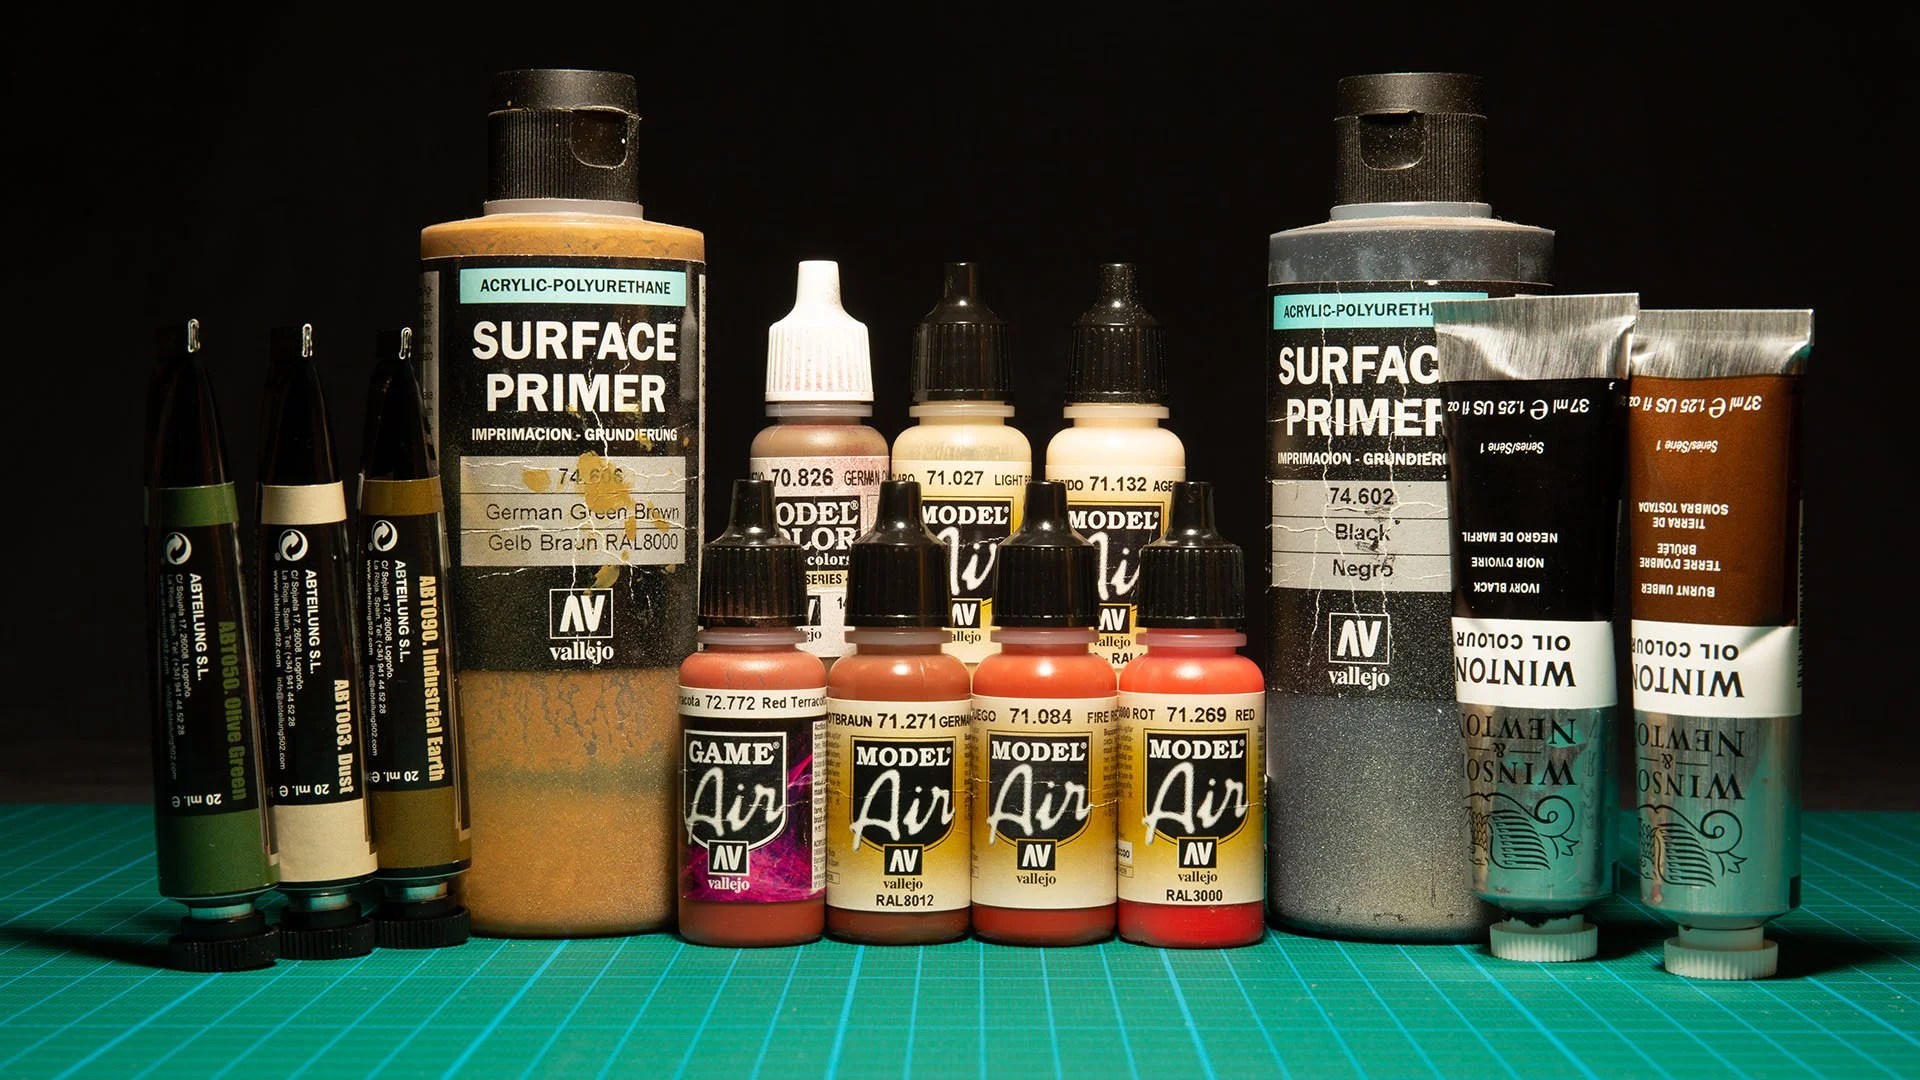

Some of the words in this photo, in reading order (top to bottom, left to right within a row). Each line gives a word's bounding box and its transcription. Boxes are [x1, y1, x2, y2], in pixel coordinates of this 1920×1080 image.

[480, 278, 671, 295] ACRYLIC-POLYURETHANE
[1284, 303, 1432, 318] ACRYLIC-POLYURETH
[472, 320, 677, 362] SURFACE
[1278, 345, 1439, 385] SURFAC
[486, 373, 666, 413] PRIMER
[1447, 401, 1459, 412] oz
[1474, 400, 1494, 416] US
[1498, 400, 1525, 415] 1.25
[1629, 396, 1640, 408] oz
[1655, 397, 1677, 413] US
[1680, 398, 1705, 413] 1.25
[584, 428, 678, 442] GRUNDIERUNG
[1480, 442, 1485, 454] 1
[1656, 440, 1661, 451] 1
[771, 468, 834, 487] 70.826
[844, 470, 879, 486] GERMAN
[927, 470, 984, 486] 71.027
[994, 475, 1022, 486] LIGHT
[1089, 476, 1147, 492] 71.132
[1153, 481, 1173, 492] AGE
[1330, 487, 1394, 505] 74.602
[486, 503, 562, 521] German
[635, 503, 680, 520] Brown
[775, 500, 858, 526] ODEL
[1639, 502, 1678, 514] TOSTADA
[1681, 503, 1729, 516] SOMBRA
[1652, 517, 1665, 528] DE
[1669, 517, 1705, 530] TIERRA
[1335, 523, 1390, 541] Black
[1462, 531, 1497, 542] MARFIL
[1499, 531, 1514, 543] DE
[1516, 532, 1558, 543] NEGRO
[488, 534, 531, 551] Gelb
[540, 534, 598, 551] Braun
[606, 533, 678, 551] RAL8000
[1333, 559, 1393, 581] Negro
[1471, 556, 1514, 568] D'IVOIRE
[1516, 557, 1545, 568] NOIR
[1639, 557, 1680, 570] D'OMBRE
[1684, 559, 1721, 572] TERRE
[381, 571, 390, 601] Sojuela
[1474, 581, 1507, 593] BLACK
[1509, 582, 1540, 593] IVORY
[1641, 583, 1674, 595] UMBER
[1676, 585, 1715, 598] BURNT
[290, 581, 299, 611] Sojuela
[395, 560, 410, 636] ABTEILUNG
[189, 573, 208, 653] ABTEILUNG
[305, 569, 320, 647] ABTEILUNG
[952, 631, 981, 644] allejo
[1098, 636, 1131, 649] allejo
[1456, 631, 1523, 650] COLOUR
[1532, 635, 1571, 651] OIL
[550, 642, 614, 664] vallejo
[1700, 643, 1739, 661] OIL
[1328, 667, 1389, 690] vallejo
[1455, 656, 1576, 687] WINTON
[378, 680, 385, 690] 44
[422, 648, 442, 734] Industrial
[379, 692, 386, 702] 52
[705, 695, 755, 710] 72.772
[762, 697, 787, 709] Red
[379, 704, 386, 714] 28
[1009, 708, 1072, 724] 71.084
[1087, 711, 1109, 724] FIRE
[1132, 707, 1155, 720] ROT
[1167, 706, 1227, 723] 71.269
[1235, 708, 1255, 721] RED
[223, 696, 243, 743] Olive
[828, 712, 873, 728] OTBRAUN
[877, 713, 936, 729] 71.271
[1637, 723, 1745, 758] NEWTO
[427, 736, 445, 782] Earth
[228, 745, 247, 801] Green
[337, 752, 354, 795] Dust
[383, 771, 400, 782] ml.
[404, 770, 419, 782] 20
[292, 784, 311, 796] ml.
[314, 783, 330, 795] 20
[1638, 768, 1745, 800] WINSO
[205, 793, 222, 806] 20
[686, 766, 785, 845] Air
[986, 763, 1092, 845] Air
[1142, 761, 1249, 846] Air
[850, 769, 956, 852] Air
[708, 877, 750, 893] vallejo
[883, 878, 923, 892] vallejo
[1016, 873, 1056, 887] vallejo
[1178, 871, 1218, 885] vallejo
[875, 894, 934, 907] RAL8012
[1166, 889, 1223, 902] RAL3000
